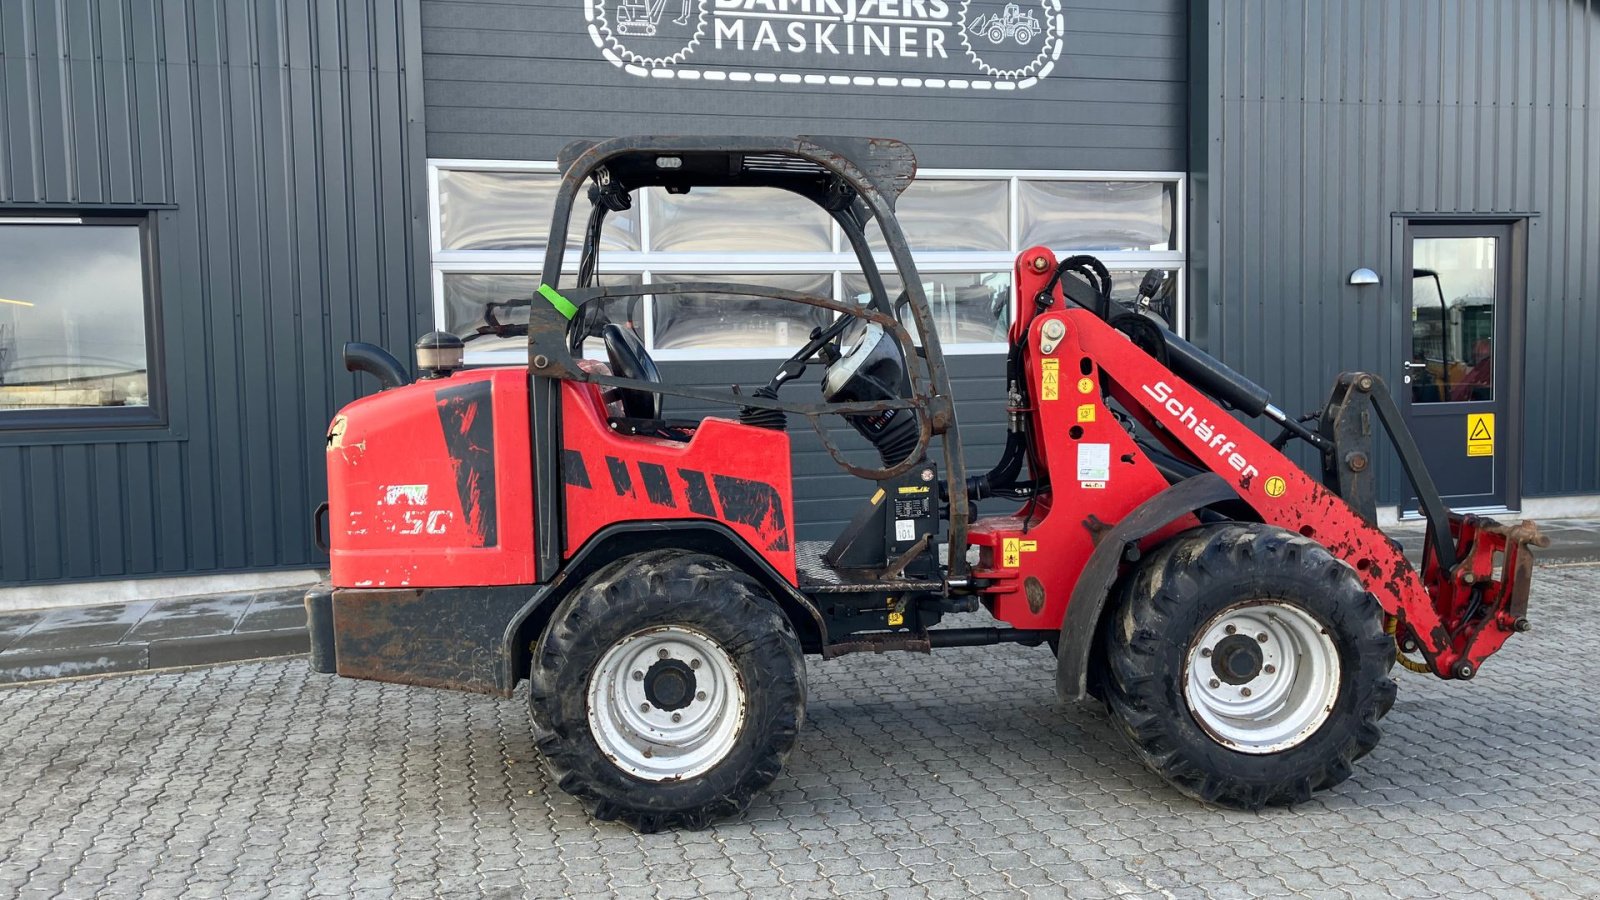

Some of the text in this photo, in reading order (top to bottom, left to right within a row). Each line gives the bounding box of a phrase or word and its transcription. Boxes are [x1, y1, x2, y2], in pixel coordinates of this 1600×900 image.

[715, 0, 949, 23] JÆRS
[714, 18, 949, 58] MASKINER
[1141, 381, 1258, 477] Schäffer
